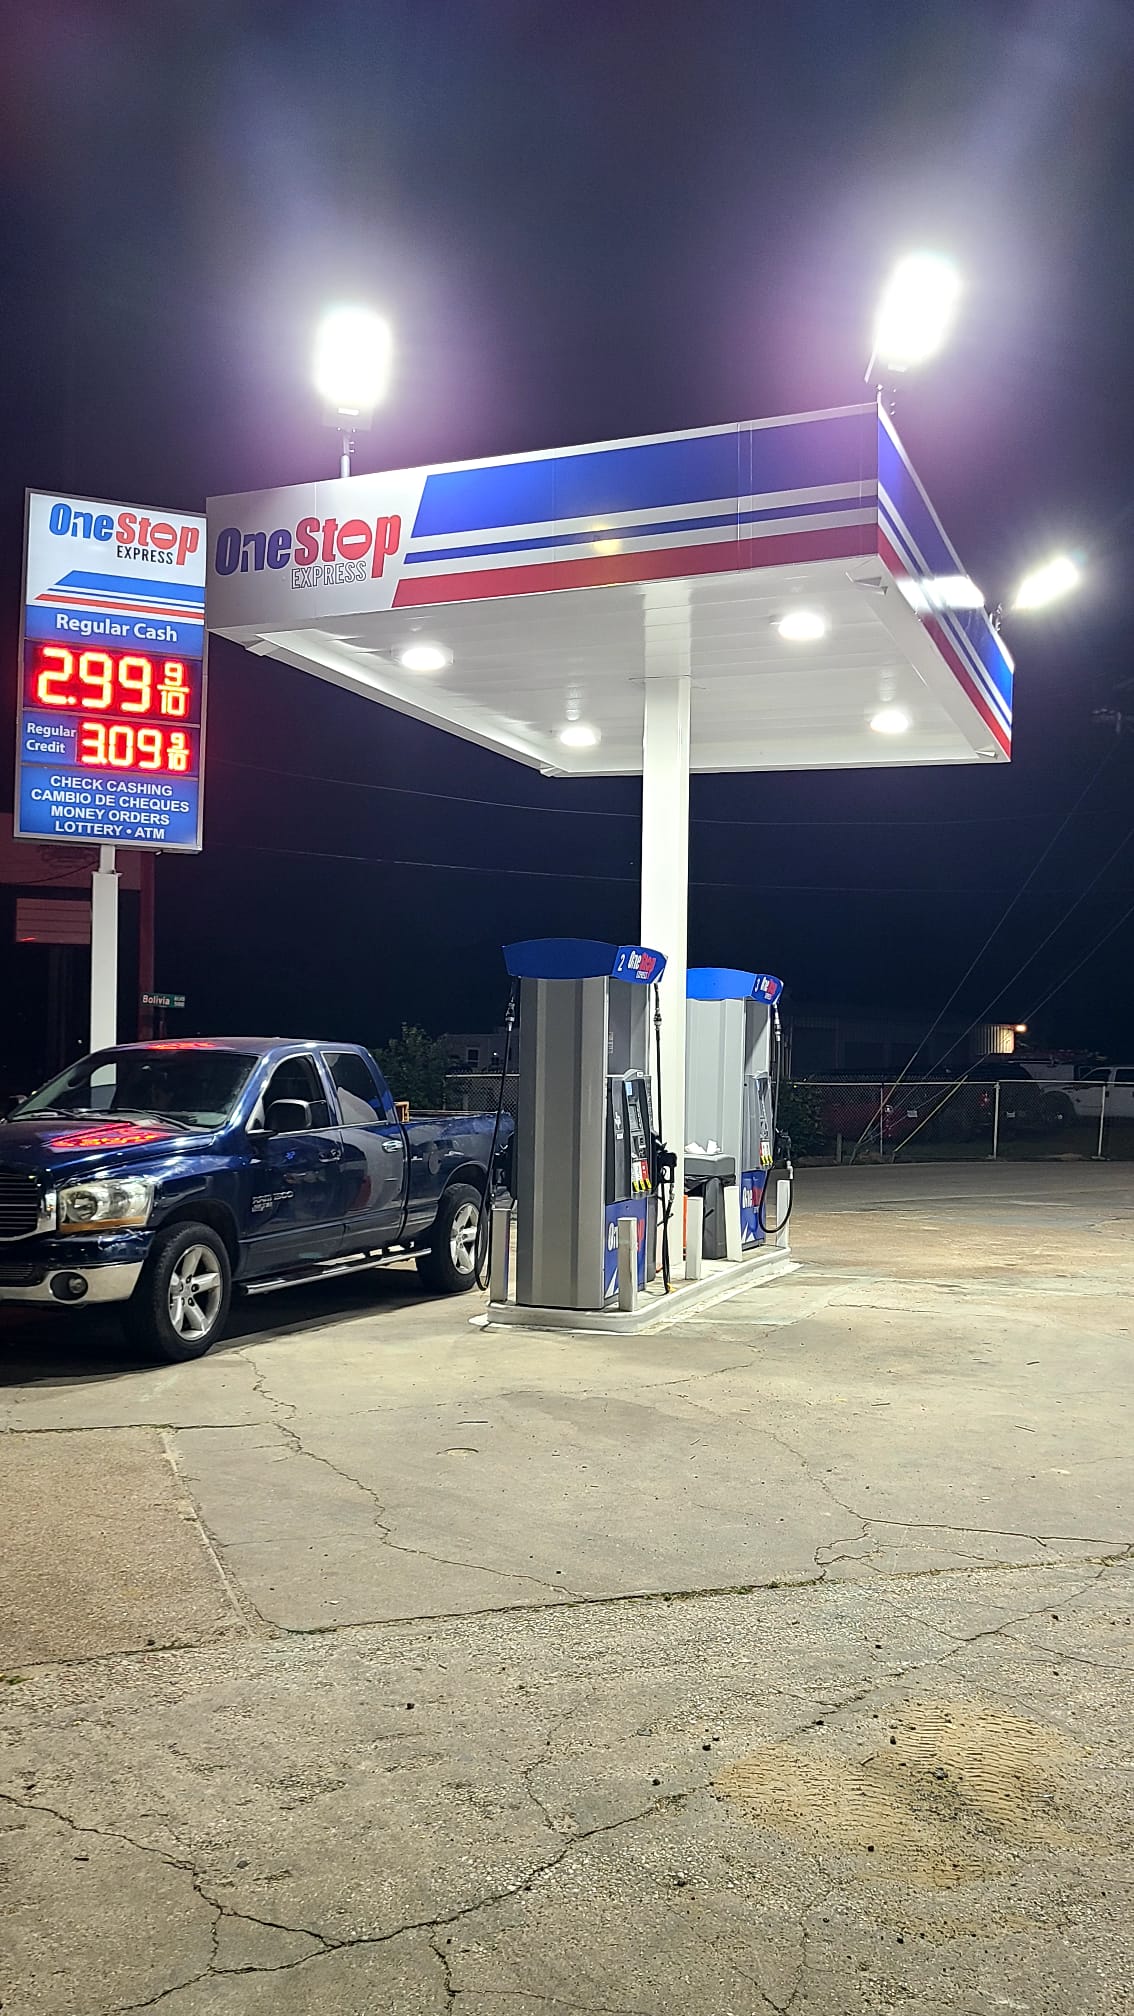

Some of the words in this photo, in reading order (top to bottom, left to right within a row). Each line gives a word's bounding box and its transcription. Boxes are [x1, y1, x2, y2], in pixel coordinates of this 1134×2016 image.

[117, 545, 173, 565] EXPRESS
[291, 560, 367, 590] EXPRESS
[56, 613, 129, 636] Regular
[133, 624, 177, 642] Cash
[27, 722, 77, 738] Regular
[26, 739, 66, 754] Credit
[50, 775, 103, 791] CHECK
[106, 780, 173, 796] CASHING
[31, 789, 92, 805] CAMBIO
[95, 795, 116, 806] DE
[119, 796, 190, 813] CHEQUES
[51, 806, 106, 819] MONEY
[108, 810, 170, 825] ORDERS
[55, 821, 123, 836] LOTTERY
[134, 827, 165, 839] ATM
[617, 953, 626, 972] 2
[142, 995, 170, 1005] Bolivia
